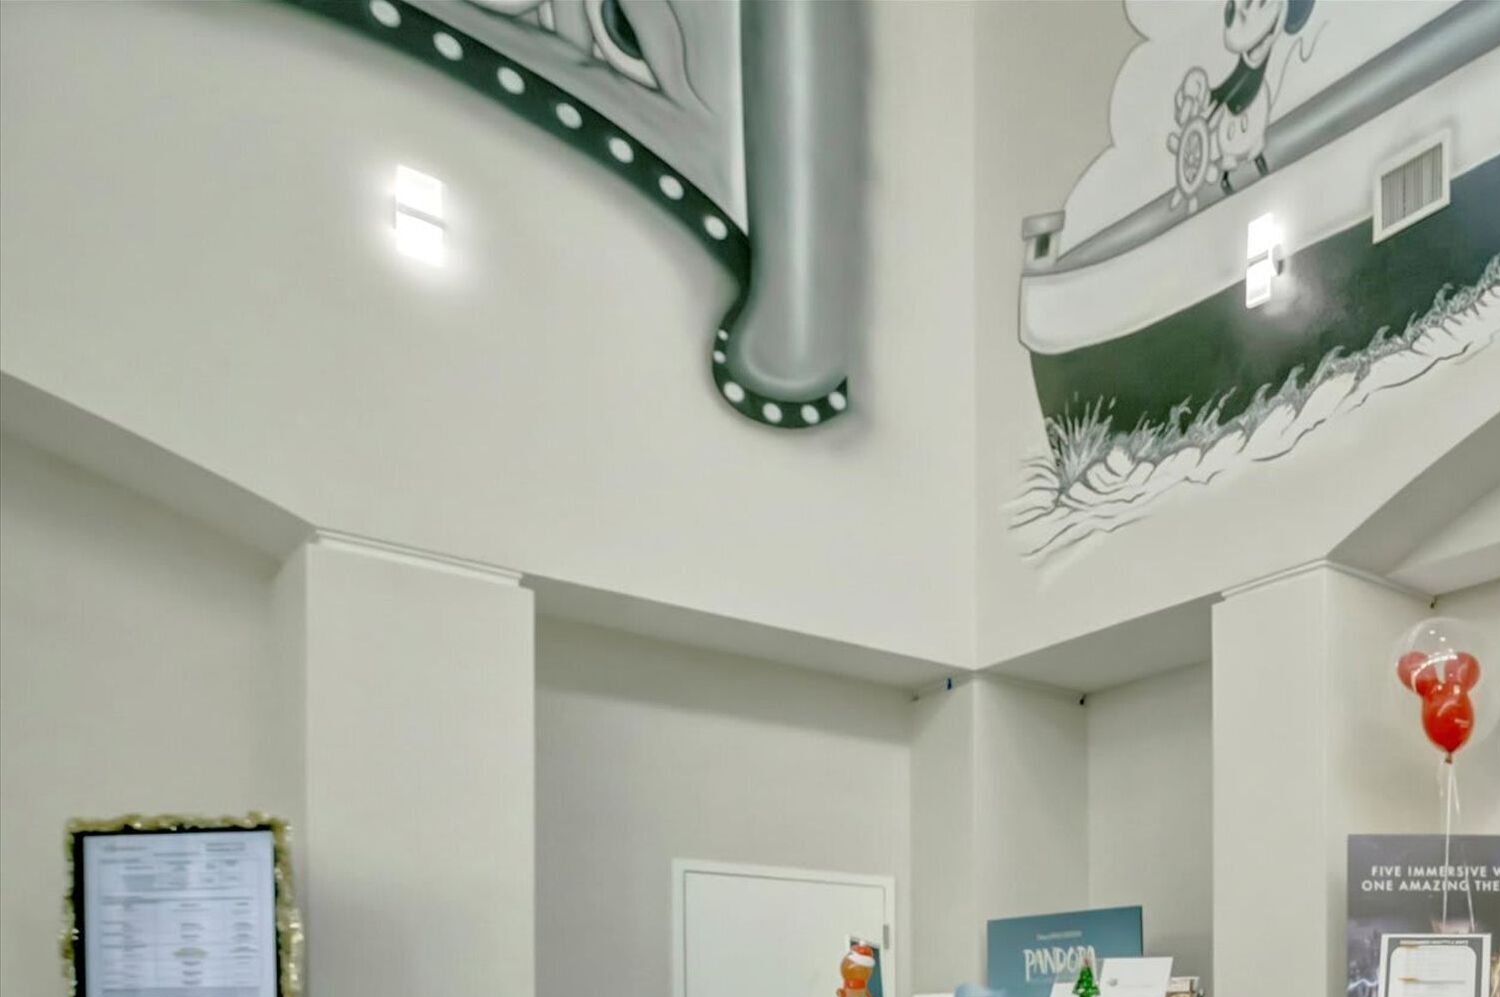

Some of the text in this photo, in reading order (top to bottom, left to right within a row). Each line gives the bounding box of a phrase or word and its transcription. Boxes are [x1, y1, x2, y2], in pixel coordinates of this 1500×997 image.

[1371, 866, 1401, 877] FIVE
[1408, 866, 1487, 878] IMMERSIVE
[1361, 880, 1394, 891] ONE
[1399, 880, 1469, 891] AMAZING
